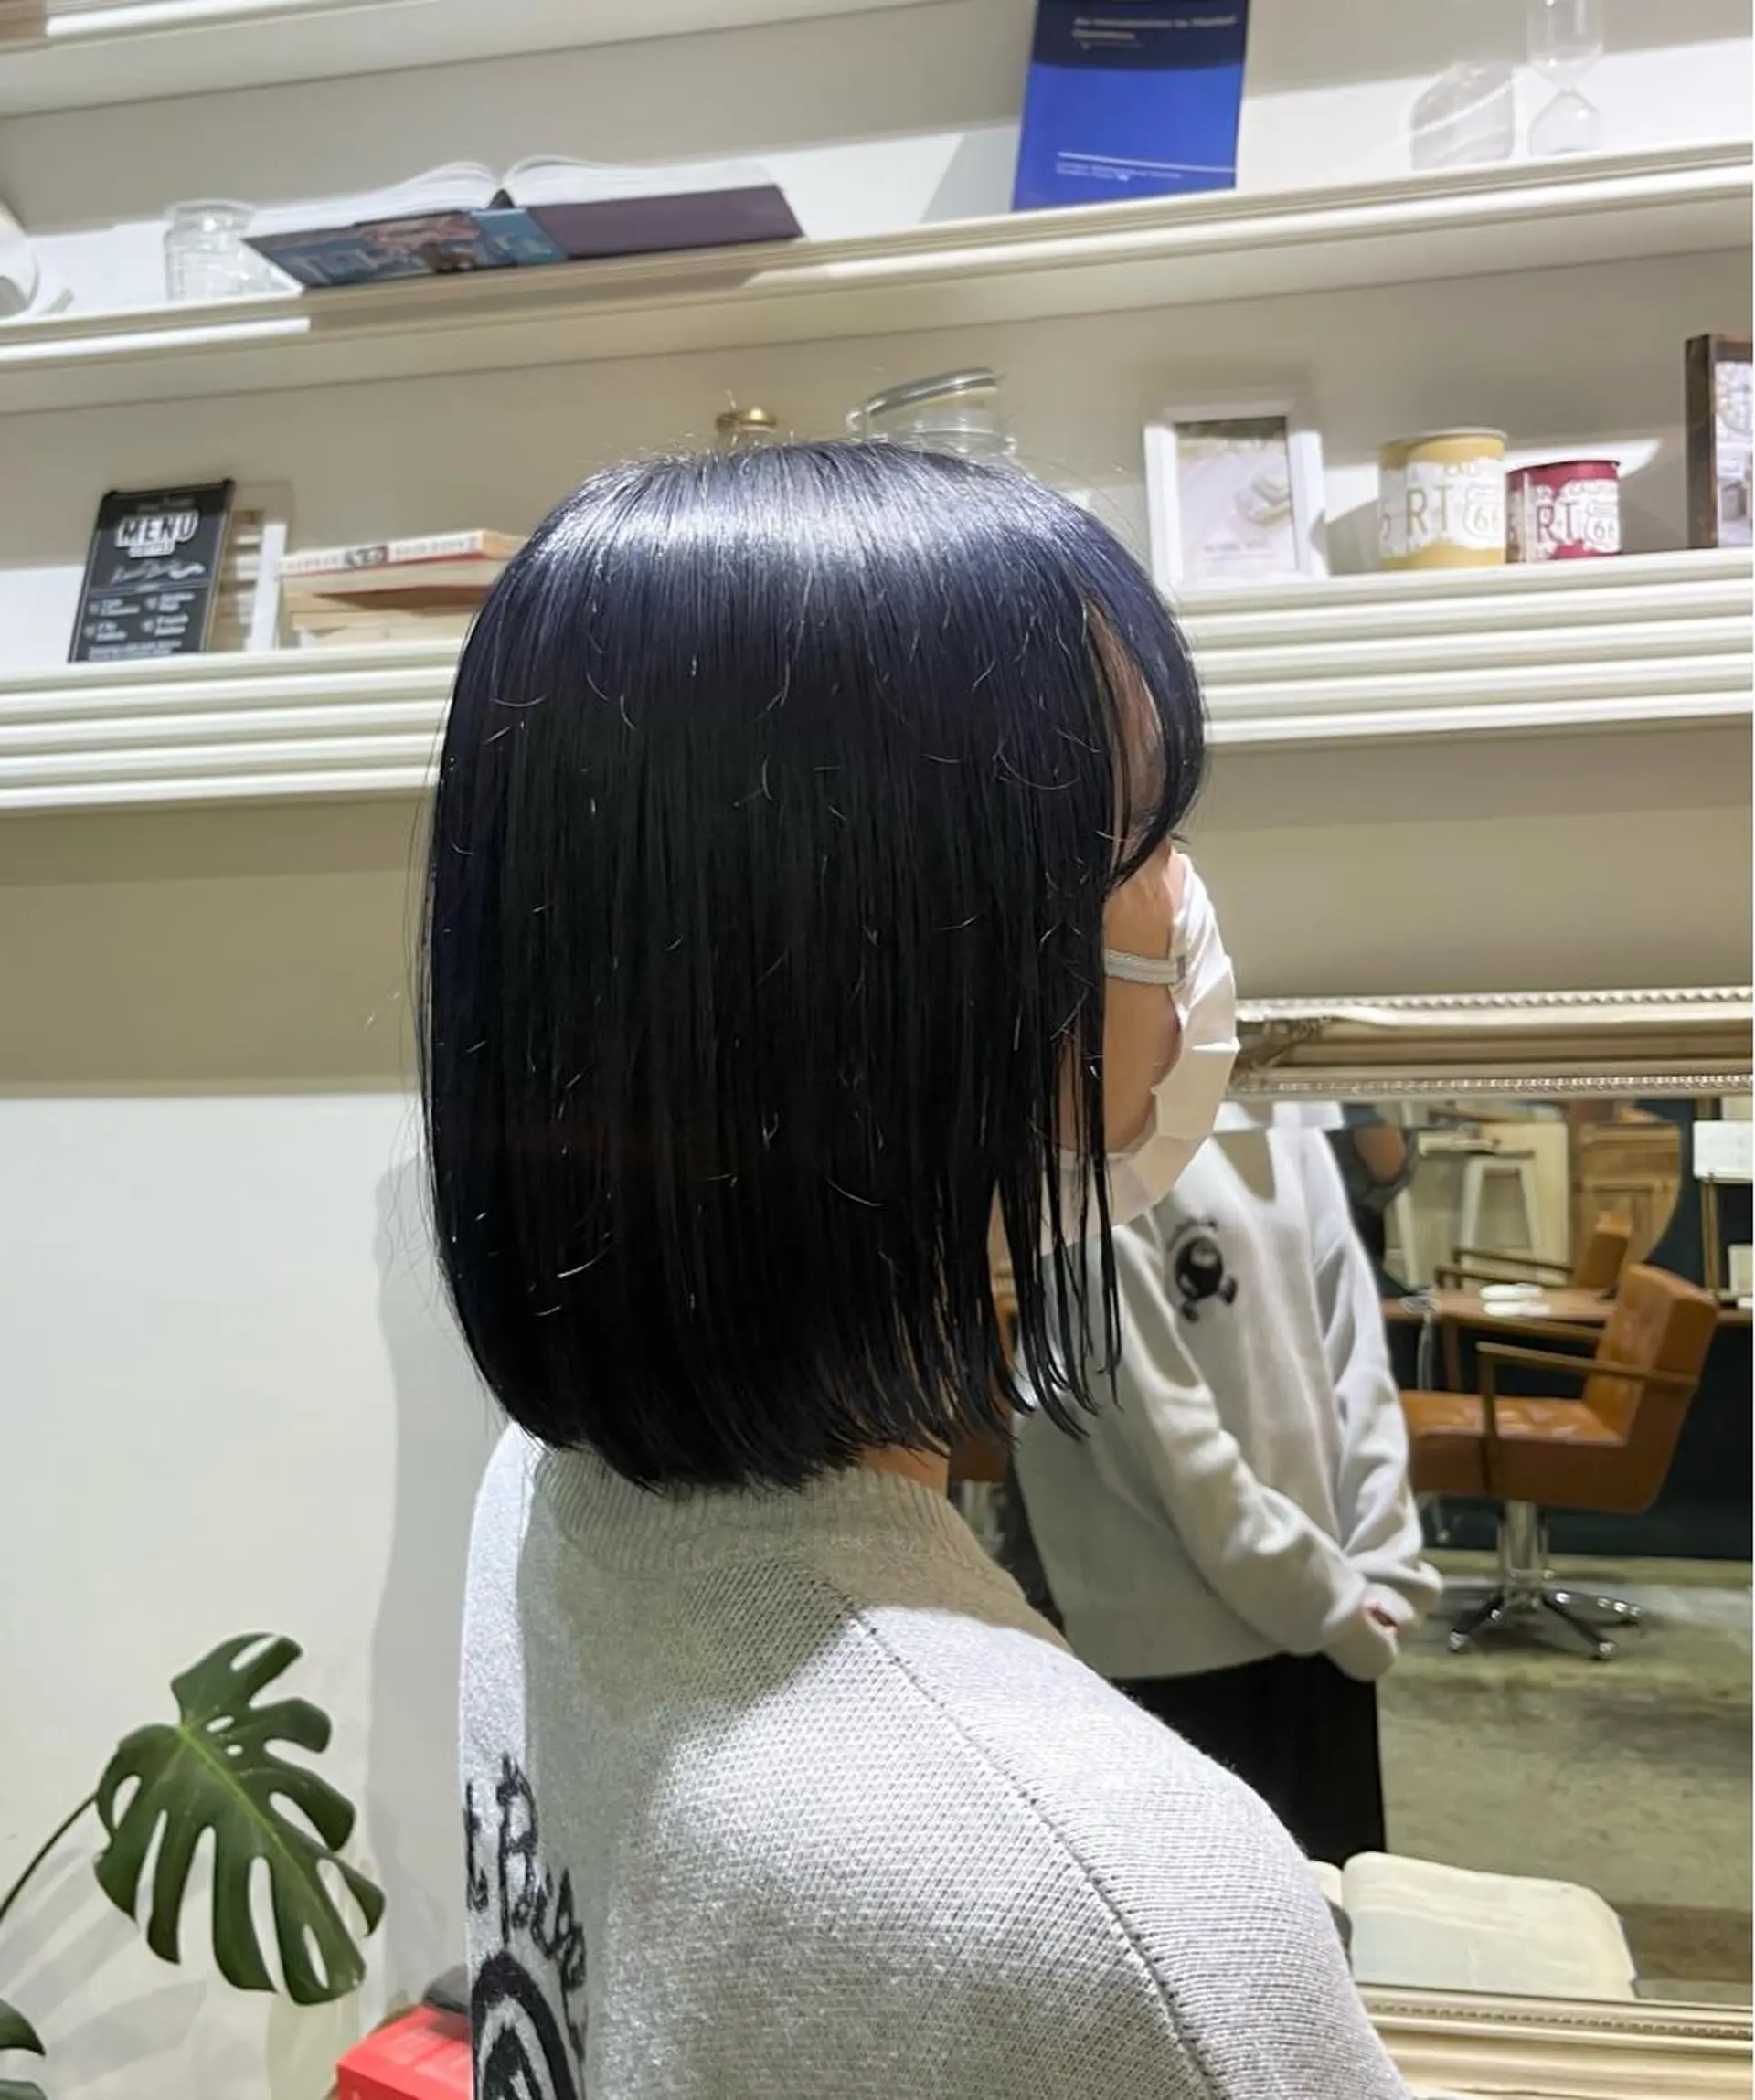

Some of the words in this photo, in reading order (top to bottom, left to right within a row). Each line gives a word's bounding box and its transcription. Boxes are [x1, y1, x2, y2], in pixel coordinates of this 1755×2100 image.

[117, 511, 199, 547] MENU
[1405, 484, 1455, 536] RT
[1536, 499, 1581, 546] RT
